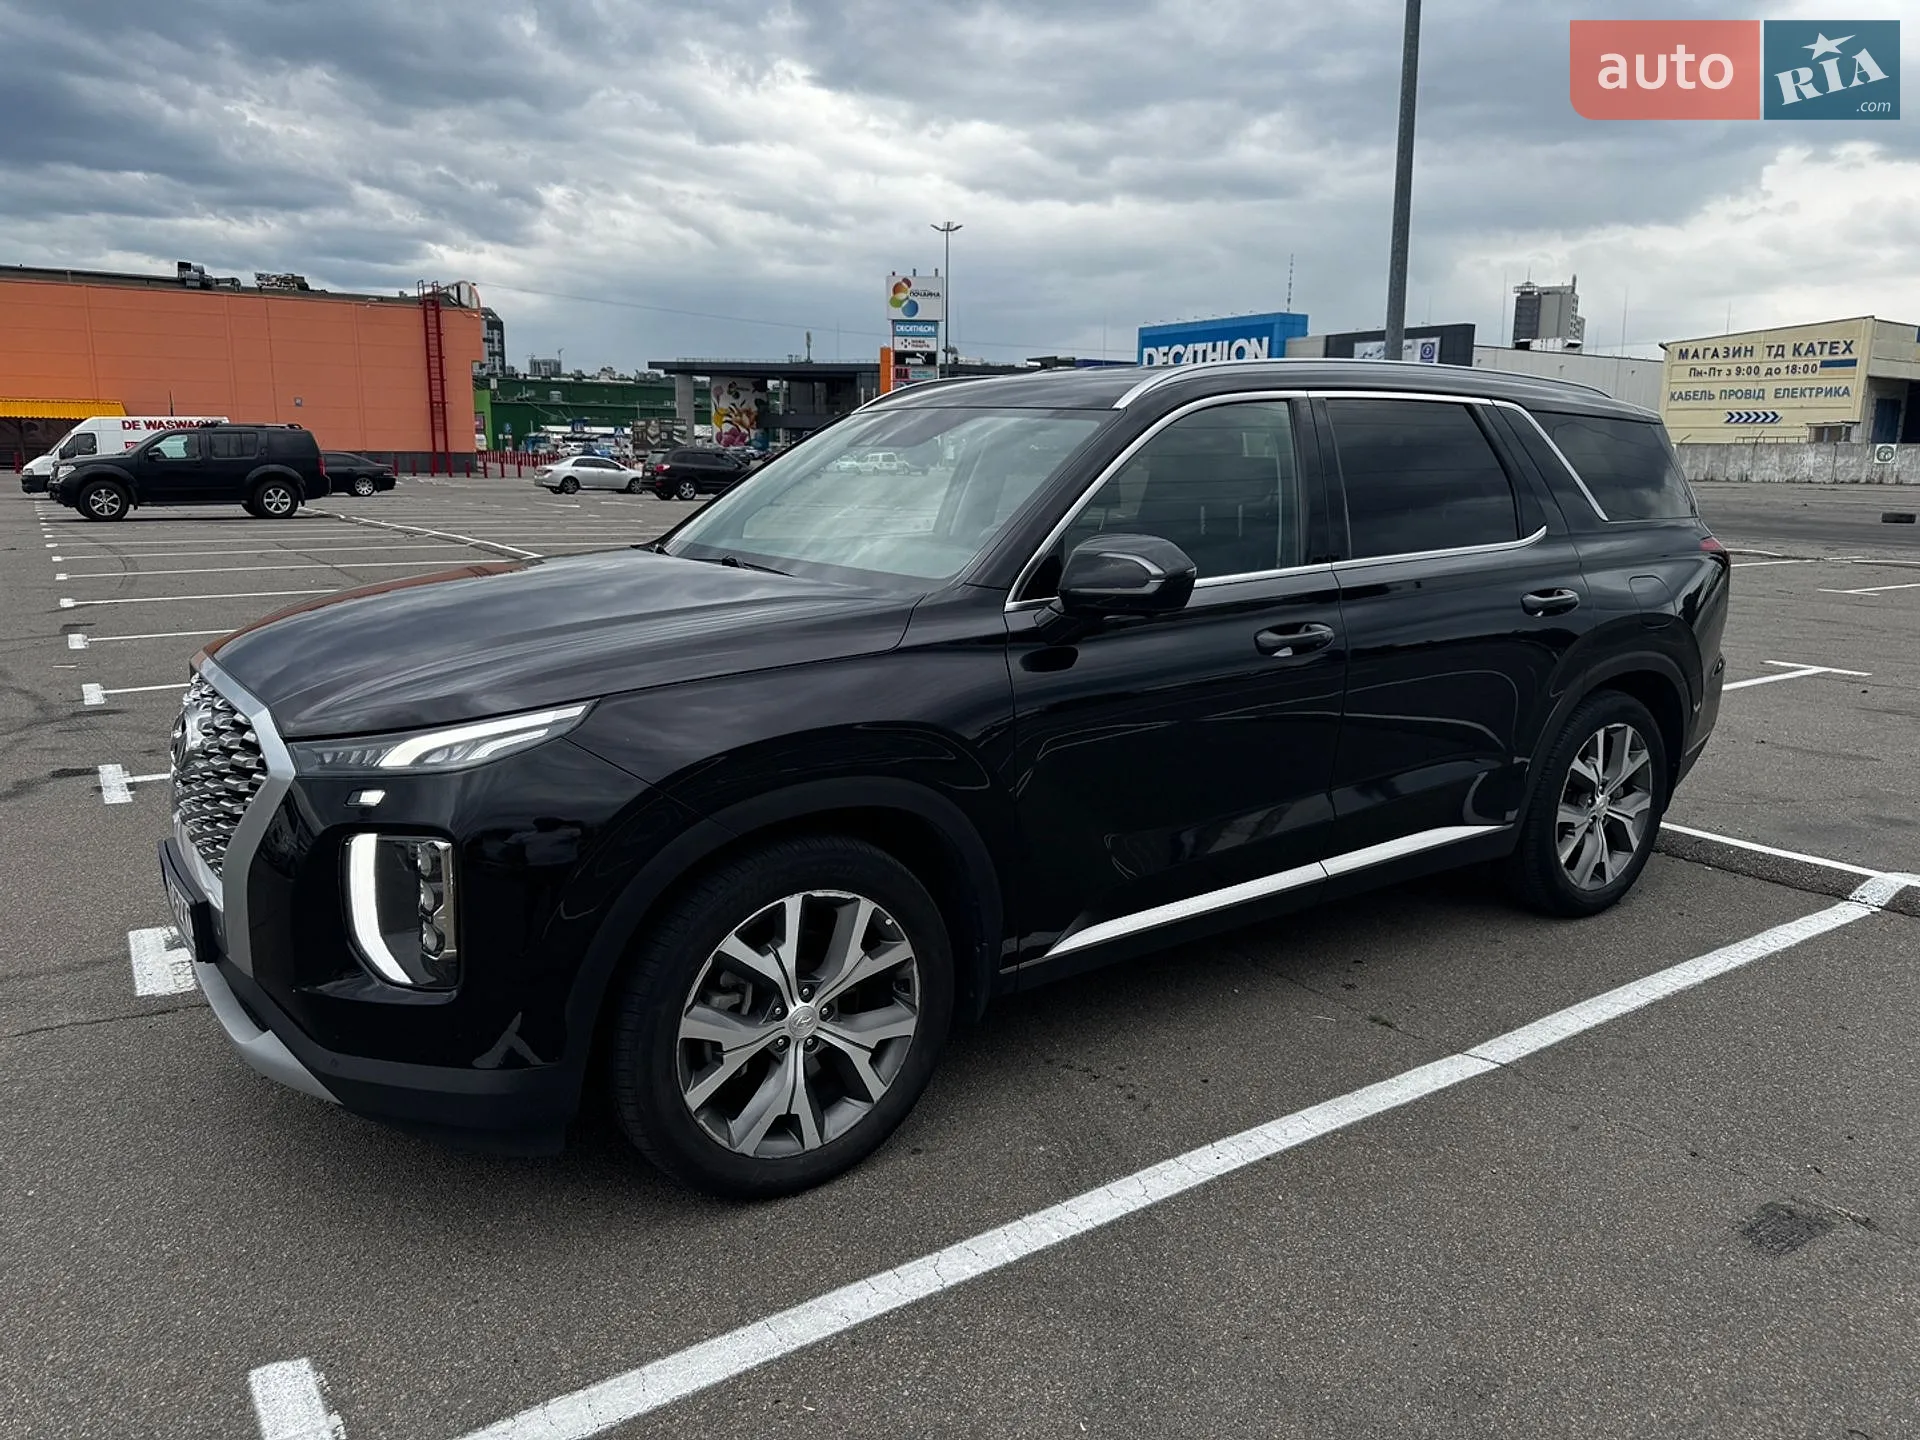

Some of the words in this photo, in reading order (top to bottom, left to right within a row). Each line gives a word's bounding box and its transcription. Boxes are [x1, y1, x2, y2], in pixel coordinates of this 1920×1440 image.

[1678, 345, 1754, 360] МАГАЗИН
[1766, 344, 1785, 359] ТД
[1792, 340, 1854, 357] КАТЕХ
[1688, 367, 1722, 378] Пн-Пт
[1735, 365, 1760, 376] 9:00
[1764, 366, 1781, 377] до
[1785, 363, 1818, 374] 18:00
[1669, 390, 1715, 401] КАБЕЛЬ
[1719, 388, 1765, 401] ПРОВІД
[1774, 385, 1851, 399] ЕЛЕКТРИКА
[121, 420, 141, 430] DE
